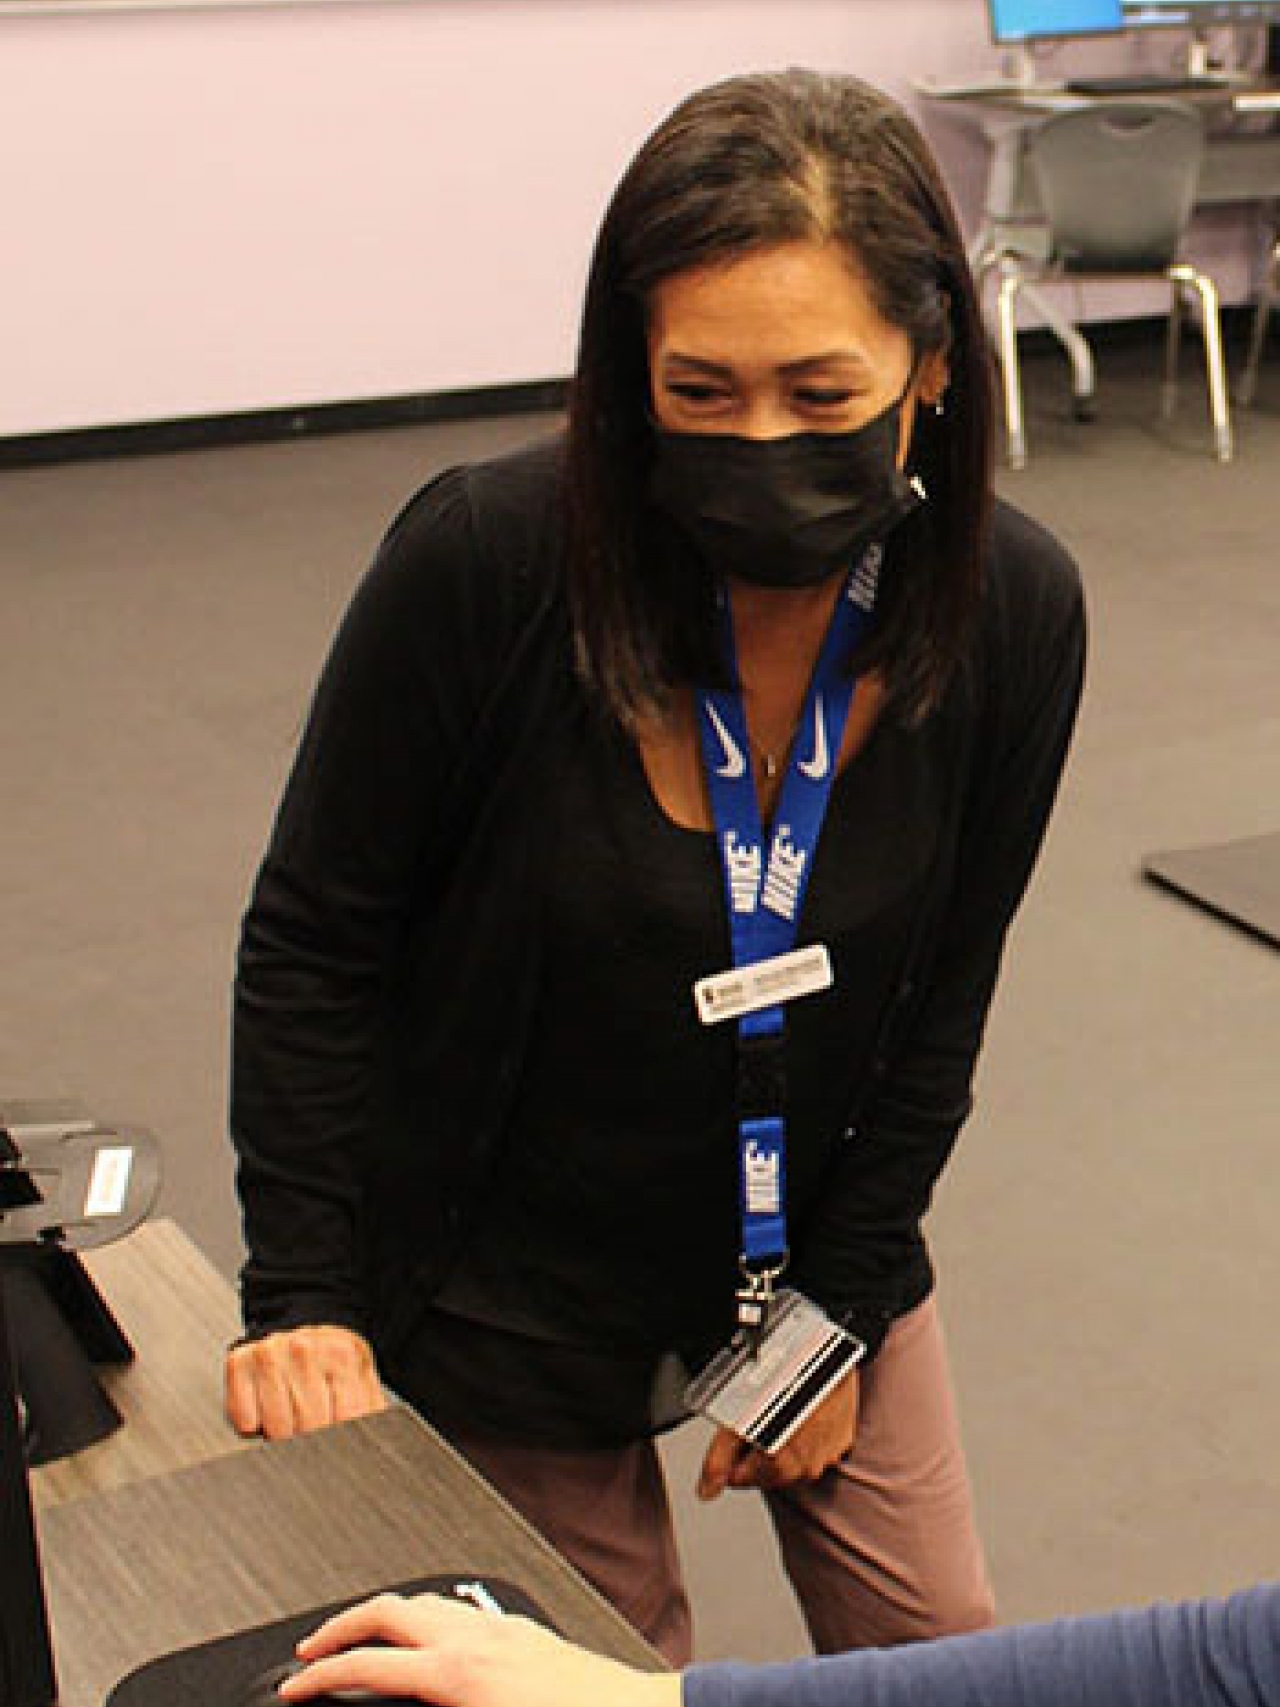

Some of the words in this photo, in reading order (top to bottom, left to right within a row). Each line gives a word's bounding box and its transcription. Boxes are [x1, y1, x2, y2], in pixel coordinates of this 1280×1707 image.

[723, 834, 761, 913] NIKE
[761, 827, 805, 920] NIKE
[745, 1143, 779, 1212] NIKE
